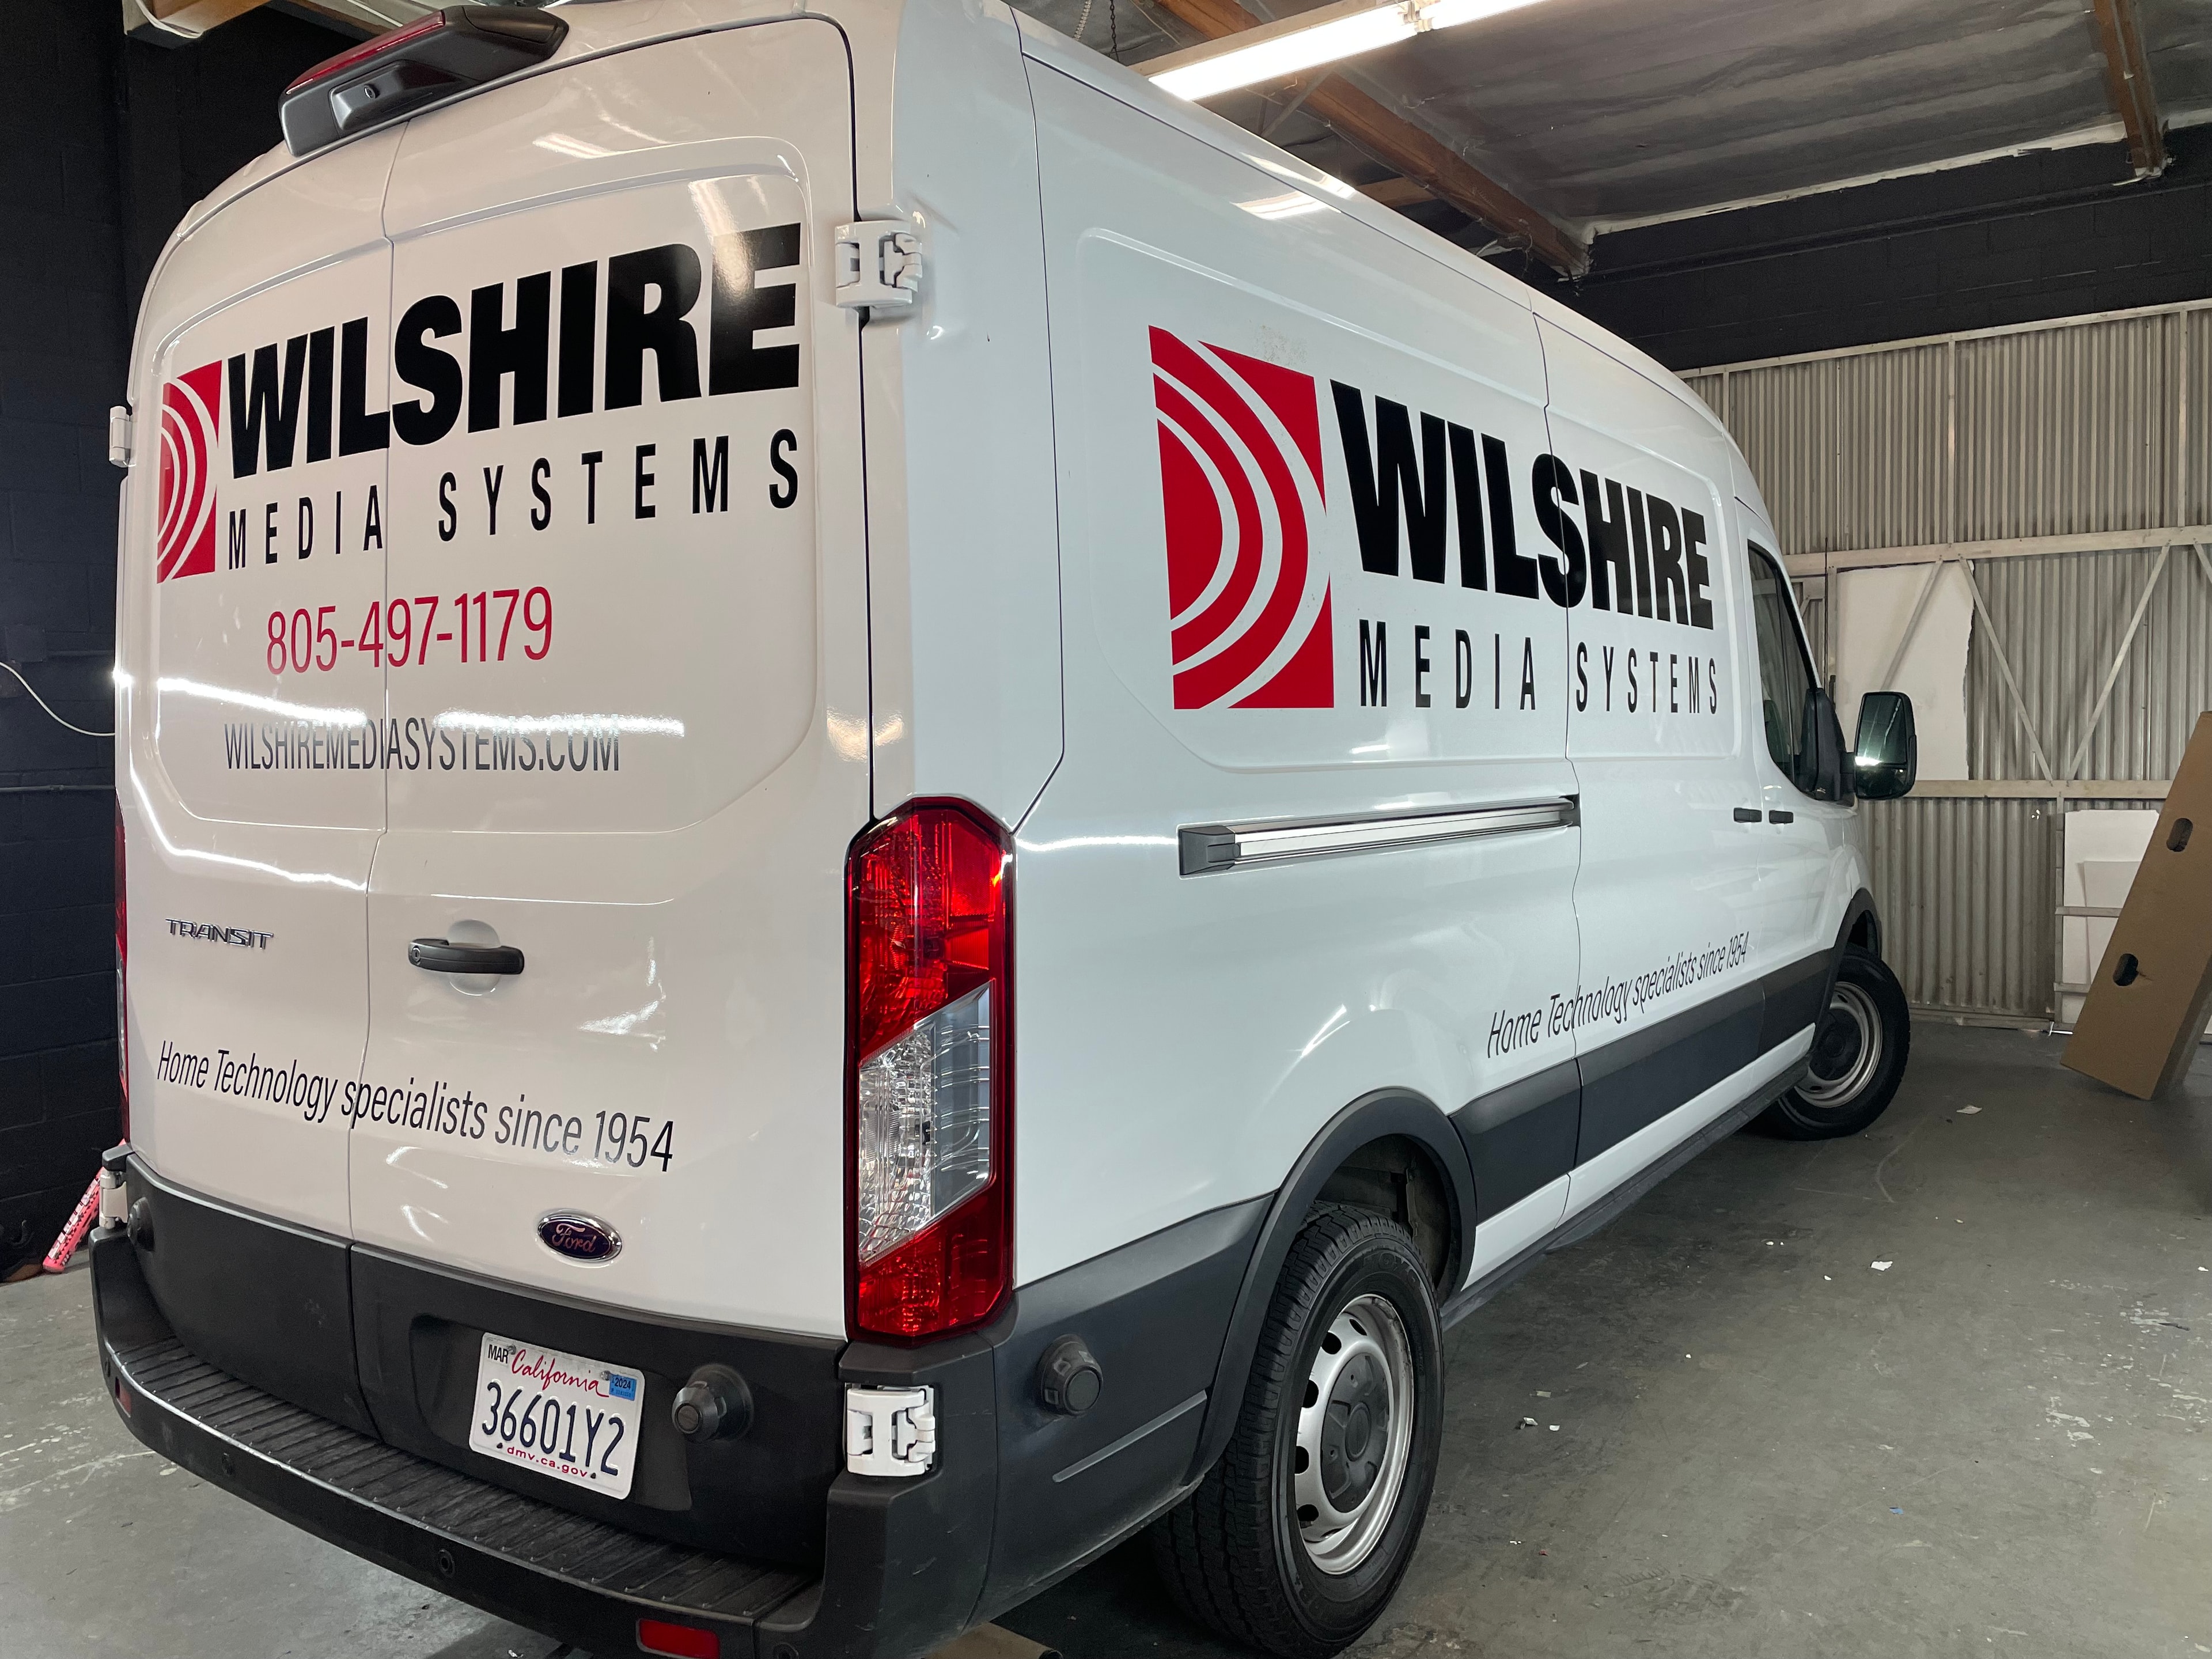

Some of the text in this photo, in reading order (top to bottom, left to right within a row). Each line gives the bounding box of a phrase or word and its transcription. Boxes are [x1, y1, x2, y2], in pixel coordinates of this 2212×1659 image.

[228, 222, 801, 479] WILSHIRE
[228, 428, 799, 570] MEDIA SYSTEMS
[1330, 378, 1714, 630] WILSHIRE
[266, 586, 553, 674] 805-497-1179
[1359, 618, 1718, 714] MEDIA SYSTEMS
[224, 717, 620, 772] WILSHIREMEDIASYSTEMS.COM
[165, 918, 274, 950] TRANSIT
[1487, 931, 1750, 1058] Home Technology specialists since 1954
[157, 1040, 674, 1172] Home Technology specialists since 1954
[551, 1222, 597, 1253] Ford
[488, 1344, 609, 1398] MAR California
[614, 1377, 631, 1390] 2024
[482, 1380, 626, 1476] 36601Y2
[506, 1446, 588, 1478] dmv.ca.gov
